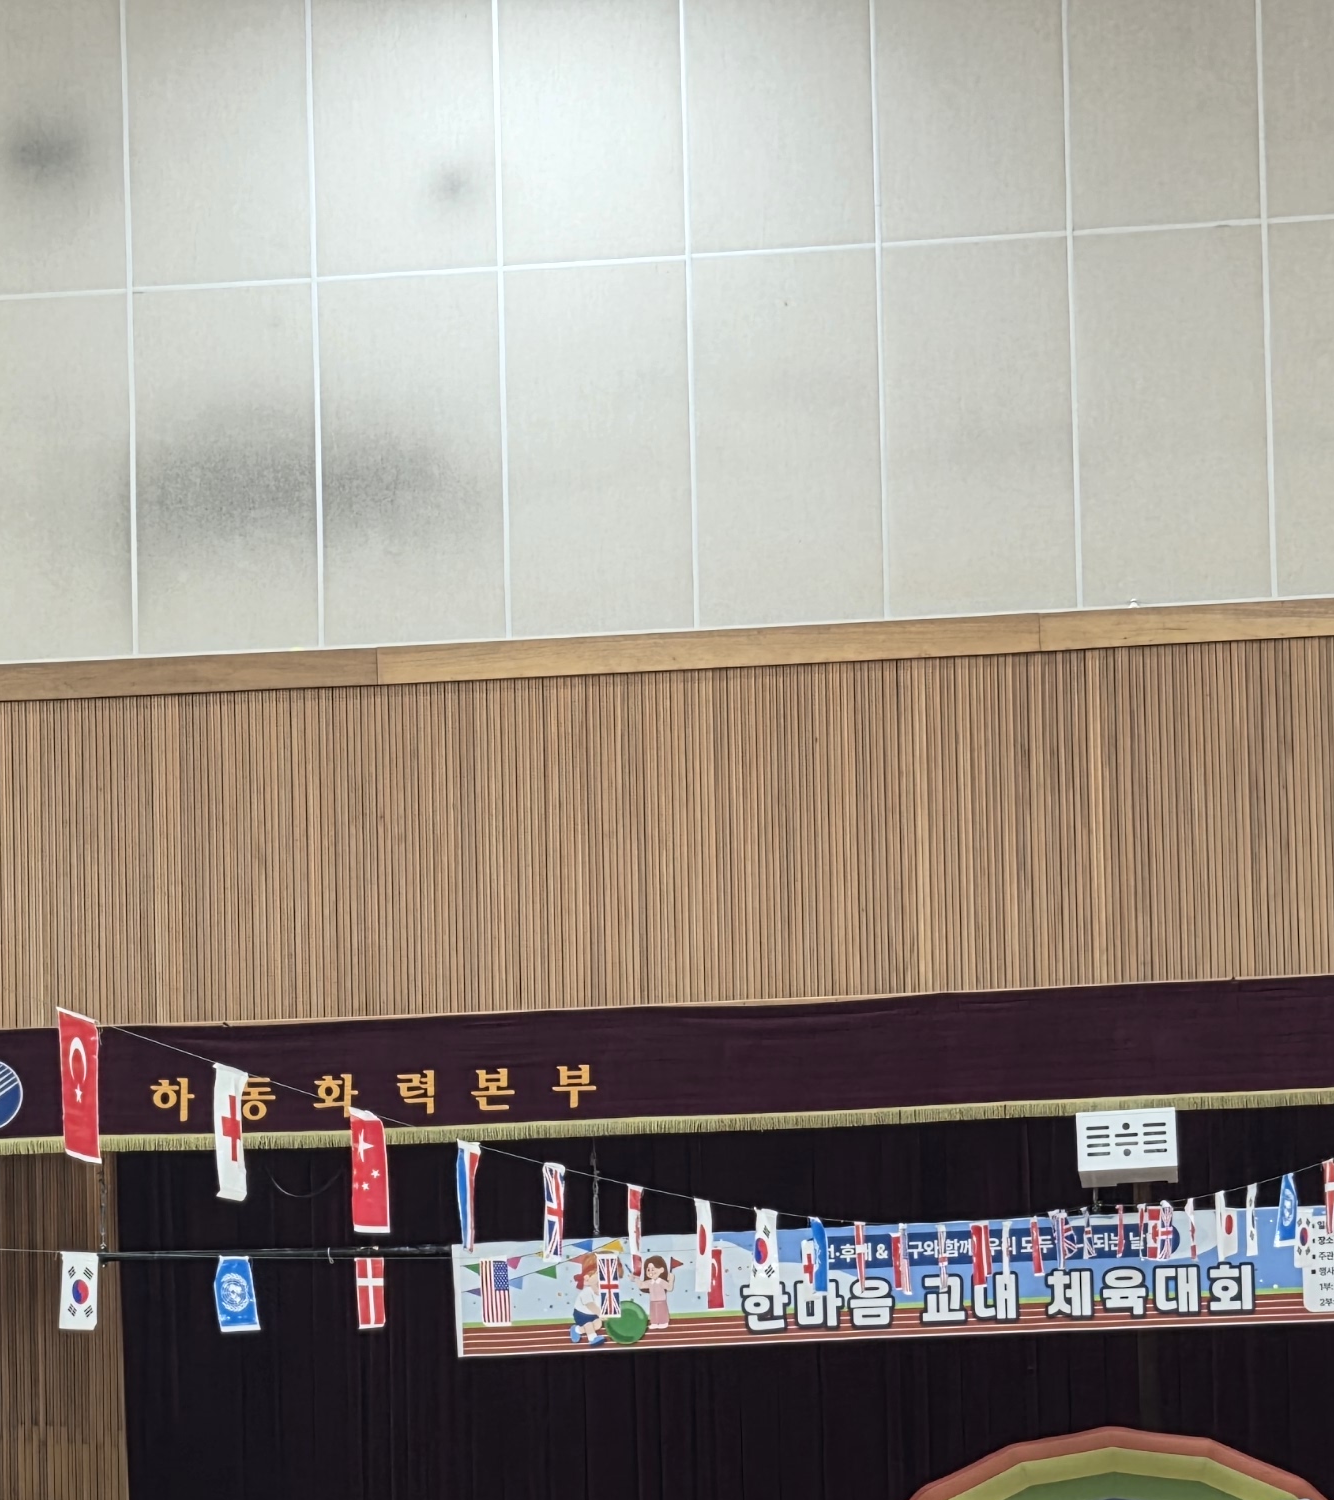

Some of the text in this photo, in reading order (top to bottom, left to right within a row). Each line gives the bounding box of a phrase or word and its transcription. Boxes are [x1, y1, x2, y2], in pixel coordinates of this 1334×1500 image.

[876, 1243, 888, 1259] &
[740, 1261, 1256, 1333] 한마음 교내 체육대회
